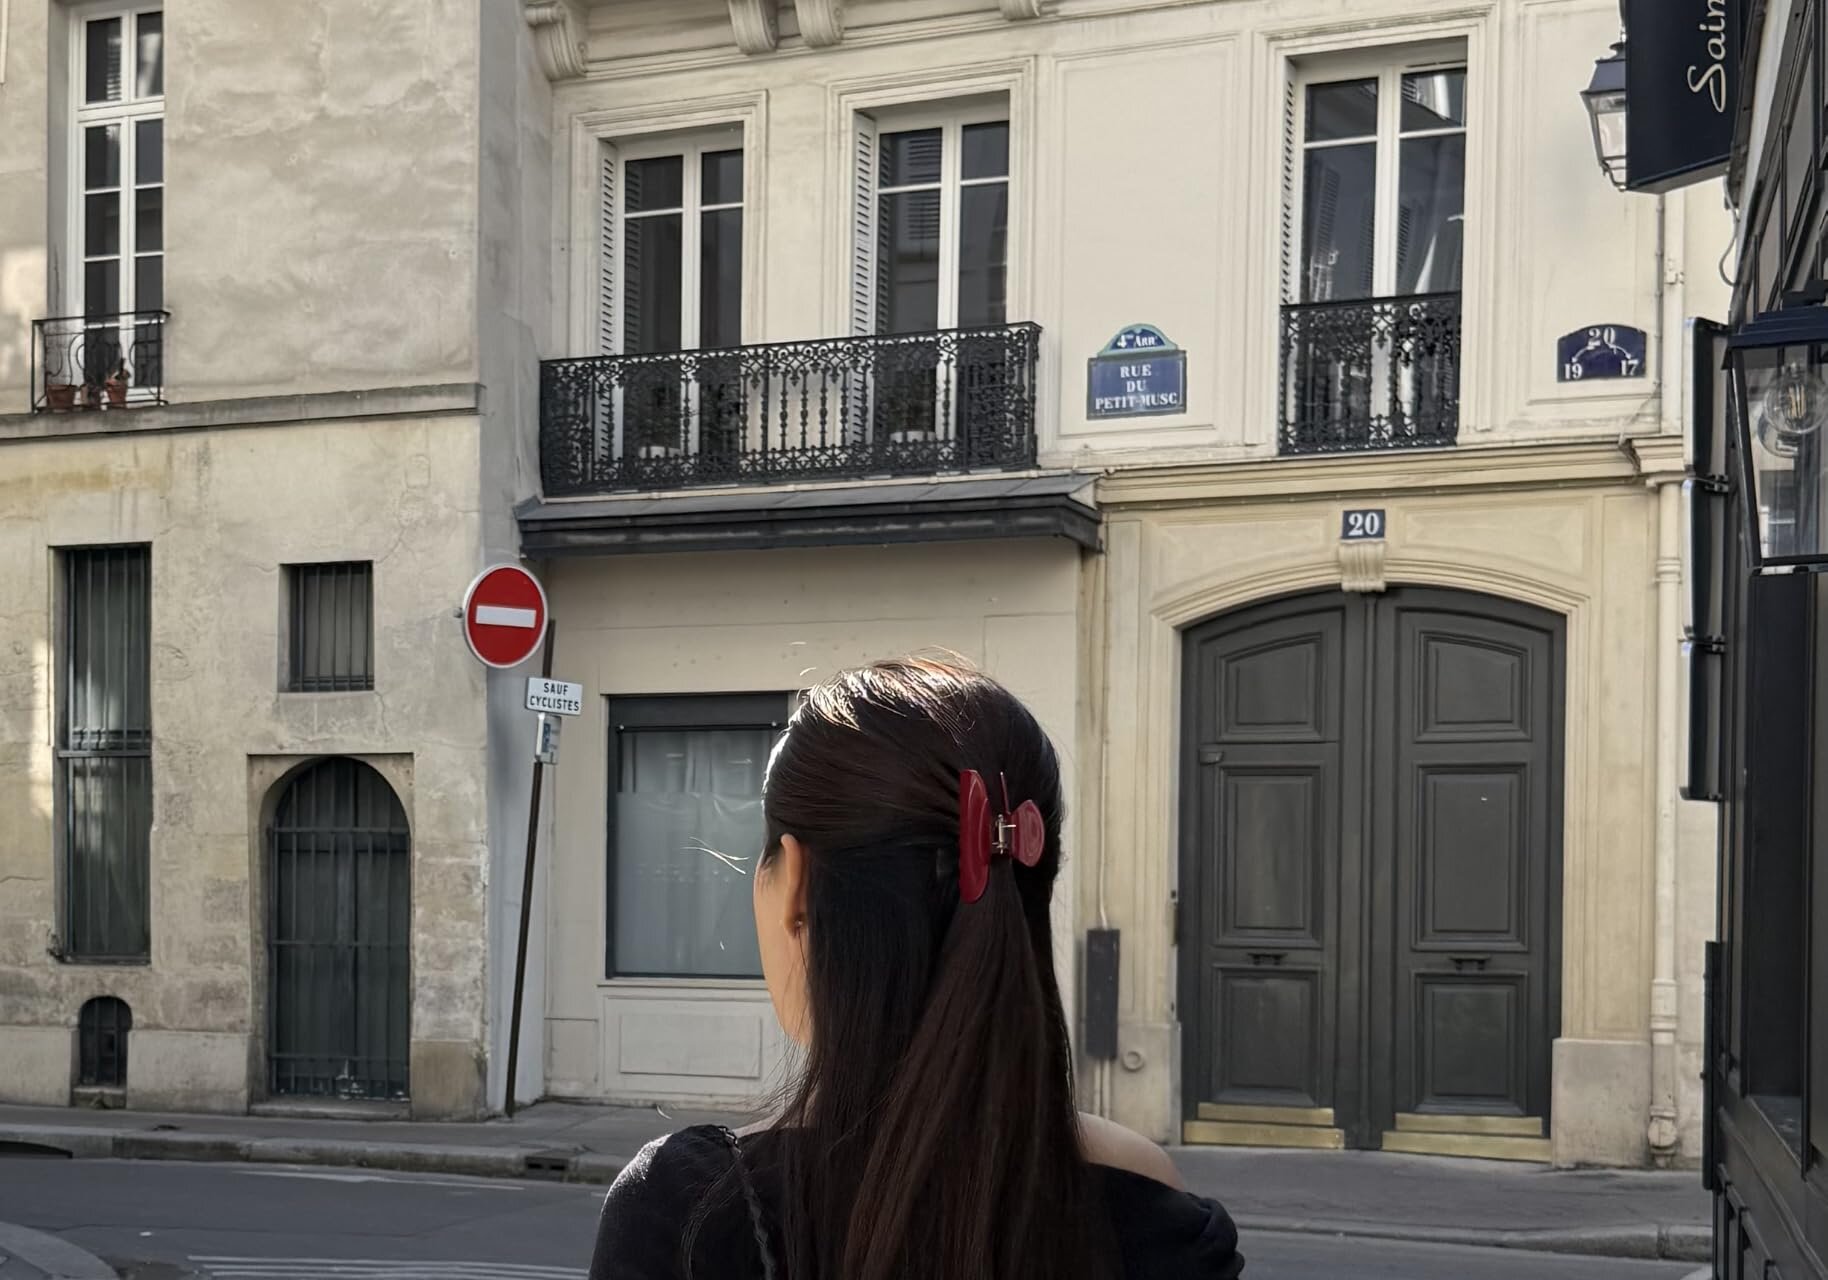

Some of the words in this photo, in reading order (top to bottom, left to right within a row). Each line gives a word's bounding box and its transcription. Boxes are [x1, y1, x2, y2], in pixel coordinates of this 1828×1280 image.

[1588, 327, 1616, 347] 20
[1120, 364, 1152, 378] RUE
[1564, 363, 1583, 380] 19
[1621, 359, 1639, 376] 17
[1126, 380, 1147, 393] DU
[1348, 512, 1380, 536] 20
[543, 682, 569, 696] SAUF
[529, 695, 580, 711] CYCLISTES
